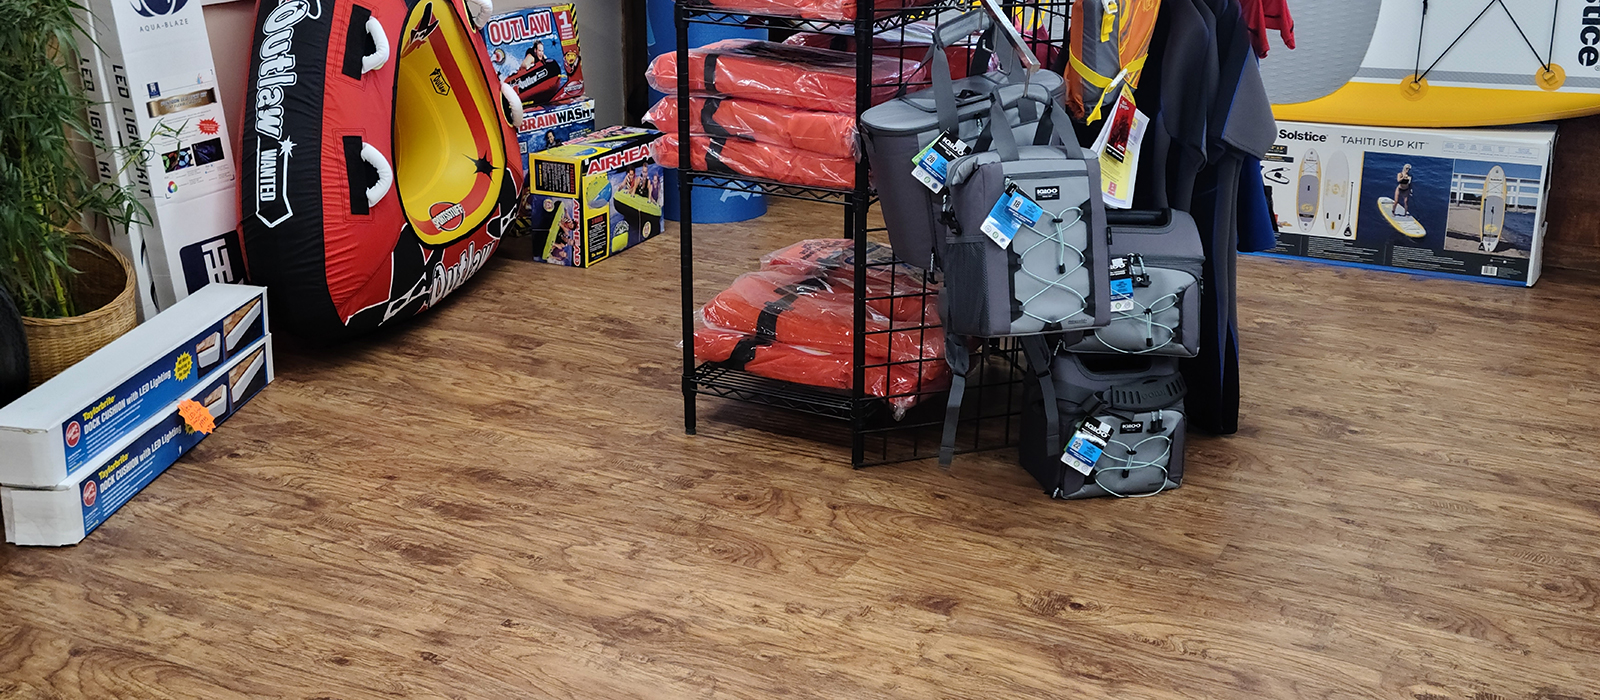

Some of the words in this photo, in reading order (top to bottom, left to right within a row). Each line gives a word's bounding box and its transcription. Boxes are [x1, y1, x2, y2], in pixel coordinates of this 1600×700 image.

[139, 18, 189, 32] AQUA-BLAZE
[488, 11, 552, 46] OUTLAW
[1578, 0, 1600, 66] tice
[255, 0, 308, 140] Outlaw
[113, 64, 130, 99] LED
[136, 167, 152, 197] KIT
[1279, 129, 1327, 142] Solstice
[1341, 135, 1376, 146] TAHITI
[1379, 138, 1404, 148] iSUP
[1407, 141, 1425, 149] KIT
[587, 142, 654, 176] AIRHEA
[927, 154, 936, 163] 28
[260, 149, 277, 201] WANTED
[1013, 199, 1021, 208] 18
[1036, 187, 1058, 195] IGLOO
[430, 240, 496, 308] Outlaw
[82, 395, 115, 421] Taylorbrite
[83, 416, 101, 435] DOCK
[101, 399, 126, 422] CUSHION
[126, 390, 139, 406] with
[139, 382, 149, 396] LED
[149, 370, 171, 390] Lighting
[1085, 422, 1107, 438] IGLOO
[100, 474, 116, 493] DOCK
[116, 455, 139, 481] CUSHION
[139, 447, 151, 462] with
[151, 438, 162, 453] LED
[161, 425, 182, 445] Lighting
[1073, 441, 1081, 450] 22
